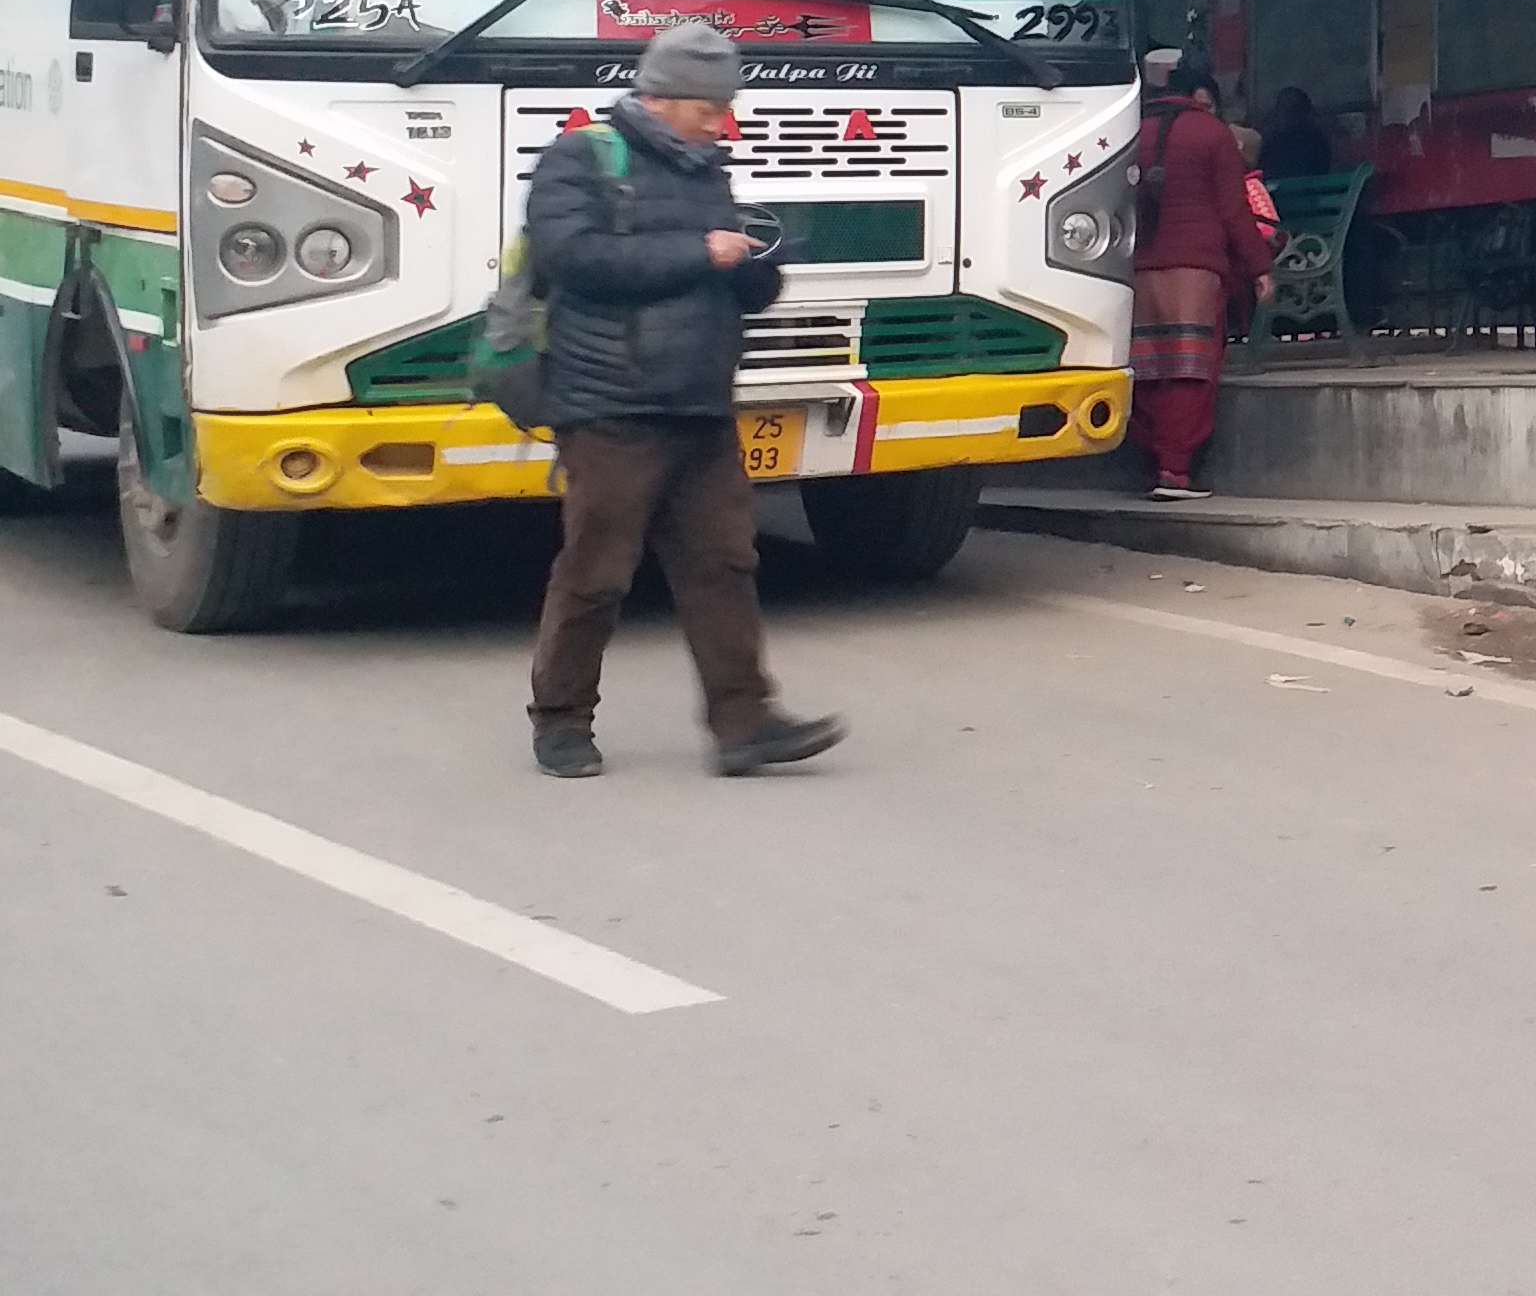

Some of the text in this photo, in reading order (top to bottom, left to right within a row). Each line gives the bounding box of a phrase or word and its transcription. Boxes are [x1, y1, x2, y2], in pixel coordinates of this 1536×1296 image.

[595, 63, 641, 83] Ja
[738, 62, 827, 83] Jalpa
[752, 414, 784, 440] 25
